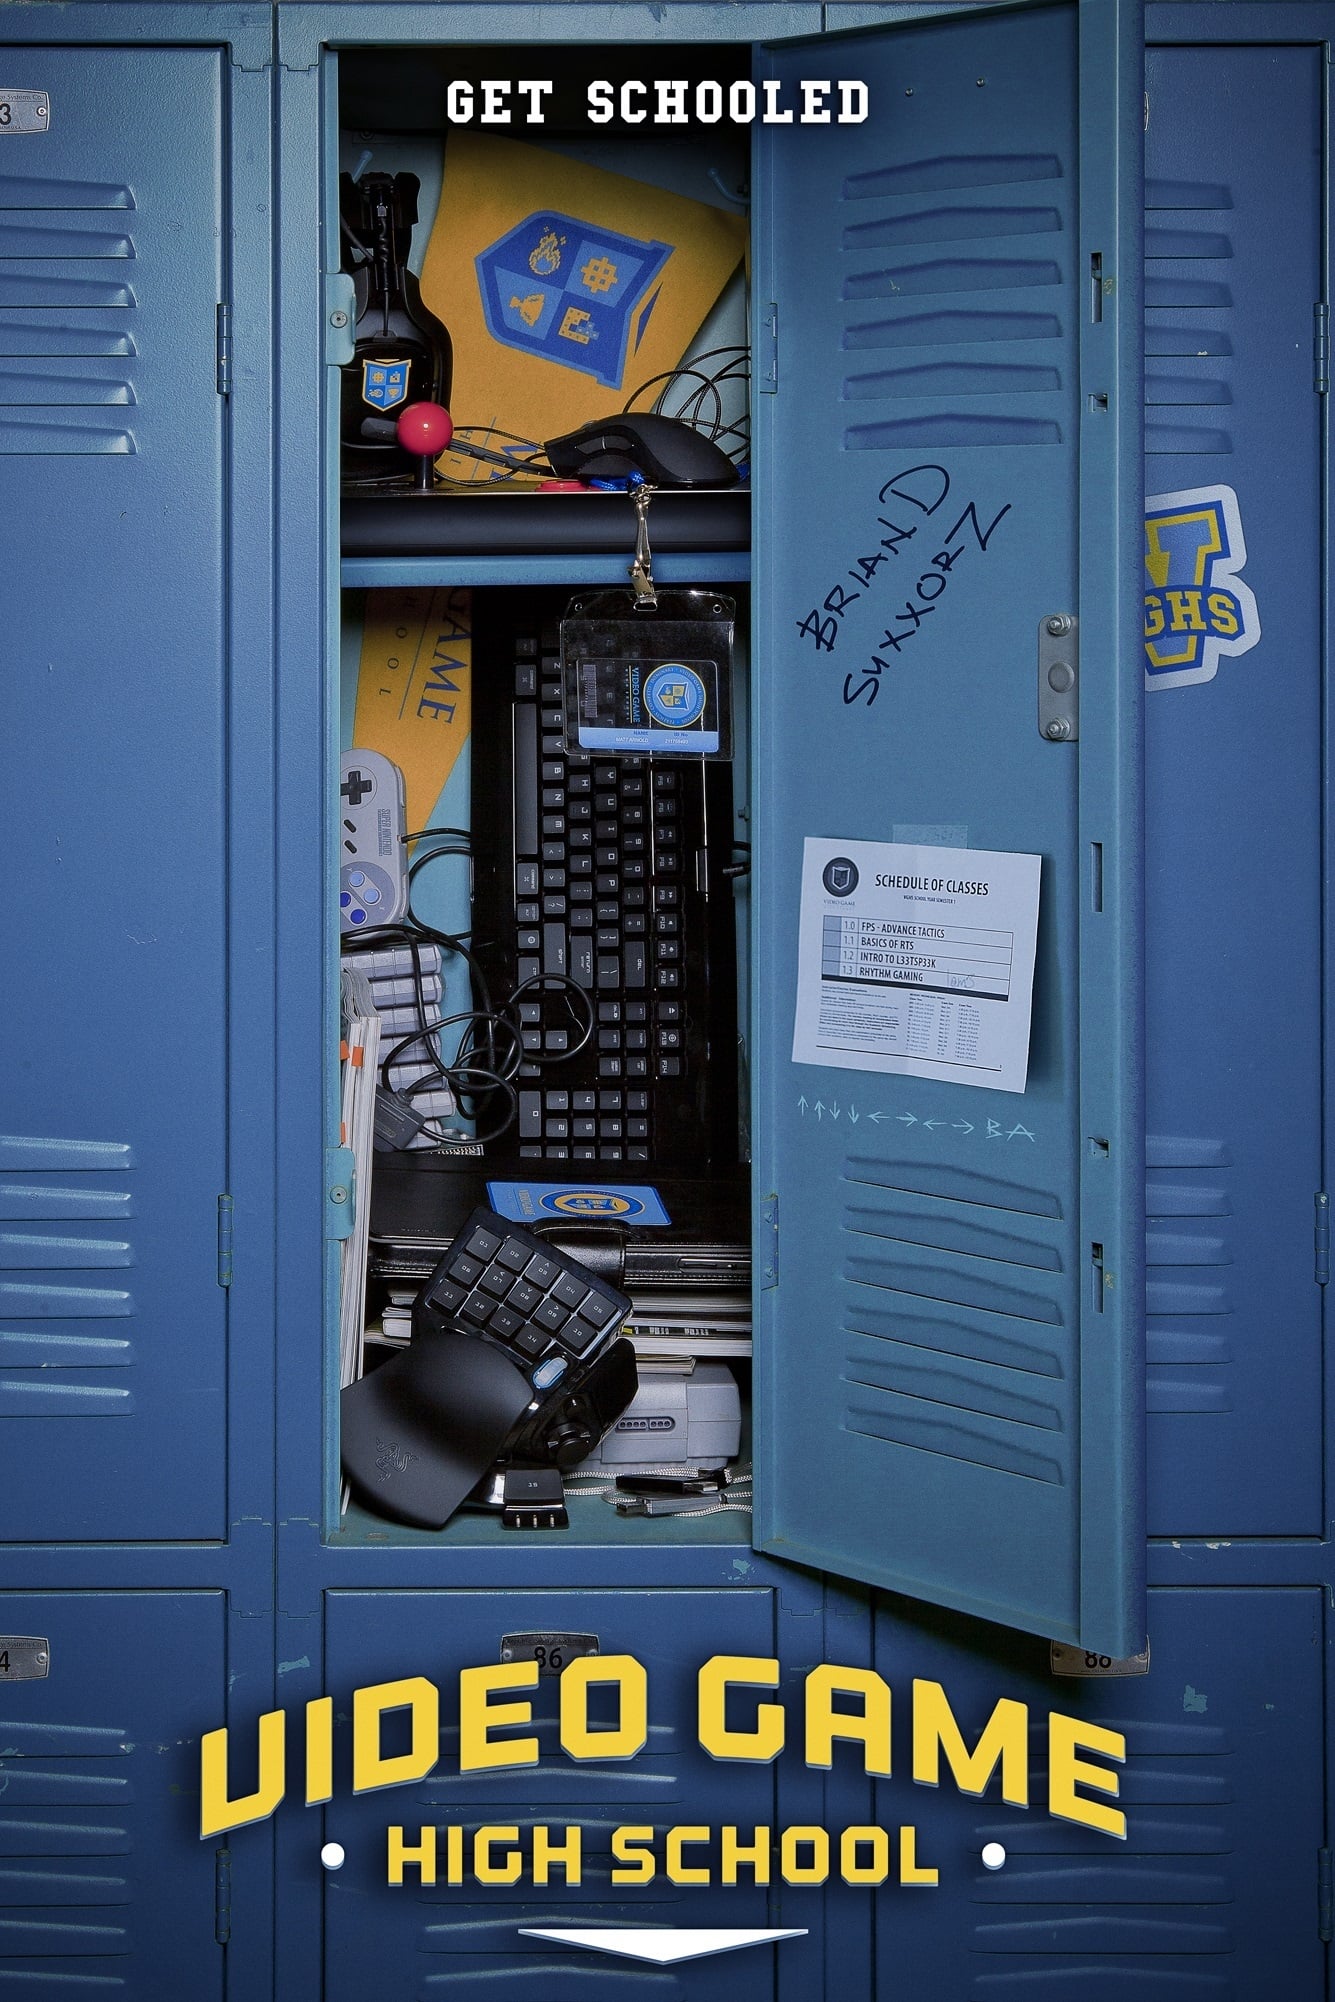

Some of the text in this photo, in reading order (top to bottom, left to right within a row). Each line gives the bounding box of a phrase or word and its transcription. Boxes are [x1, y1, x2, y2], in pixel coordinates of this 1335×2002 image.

[0, 103, 11, 125] 3
[632, 666, 641, 723] VIDEO GAME
[875, 874, 988, 896] SCHEDULE OF CLASSES
[844, 920, 855, 930] 1.0
[862, 922, 875, 932] FPS
[881, 924, 917, 936] ADVANCE
[918, 926, 945, 938] TACTICS
[844, 936, 914, 950] 1.1 BASICS OF RTS
[844, 950, 936, 968] 1.2 INTRO TO L33TSP33K
[842, 965, 923, 982] 1.3 RHYTHM GAMING
[986, 1118, 1036, 1142] B A
[0, 1650, 10, 1672] 4
[534, 1646, 562, 1668] 86
